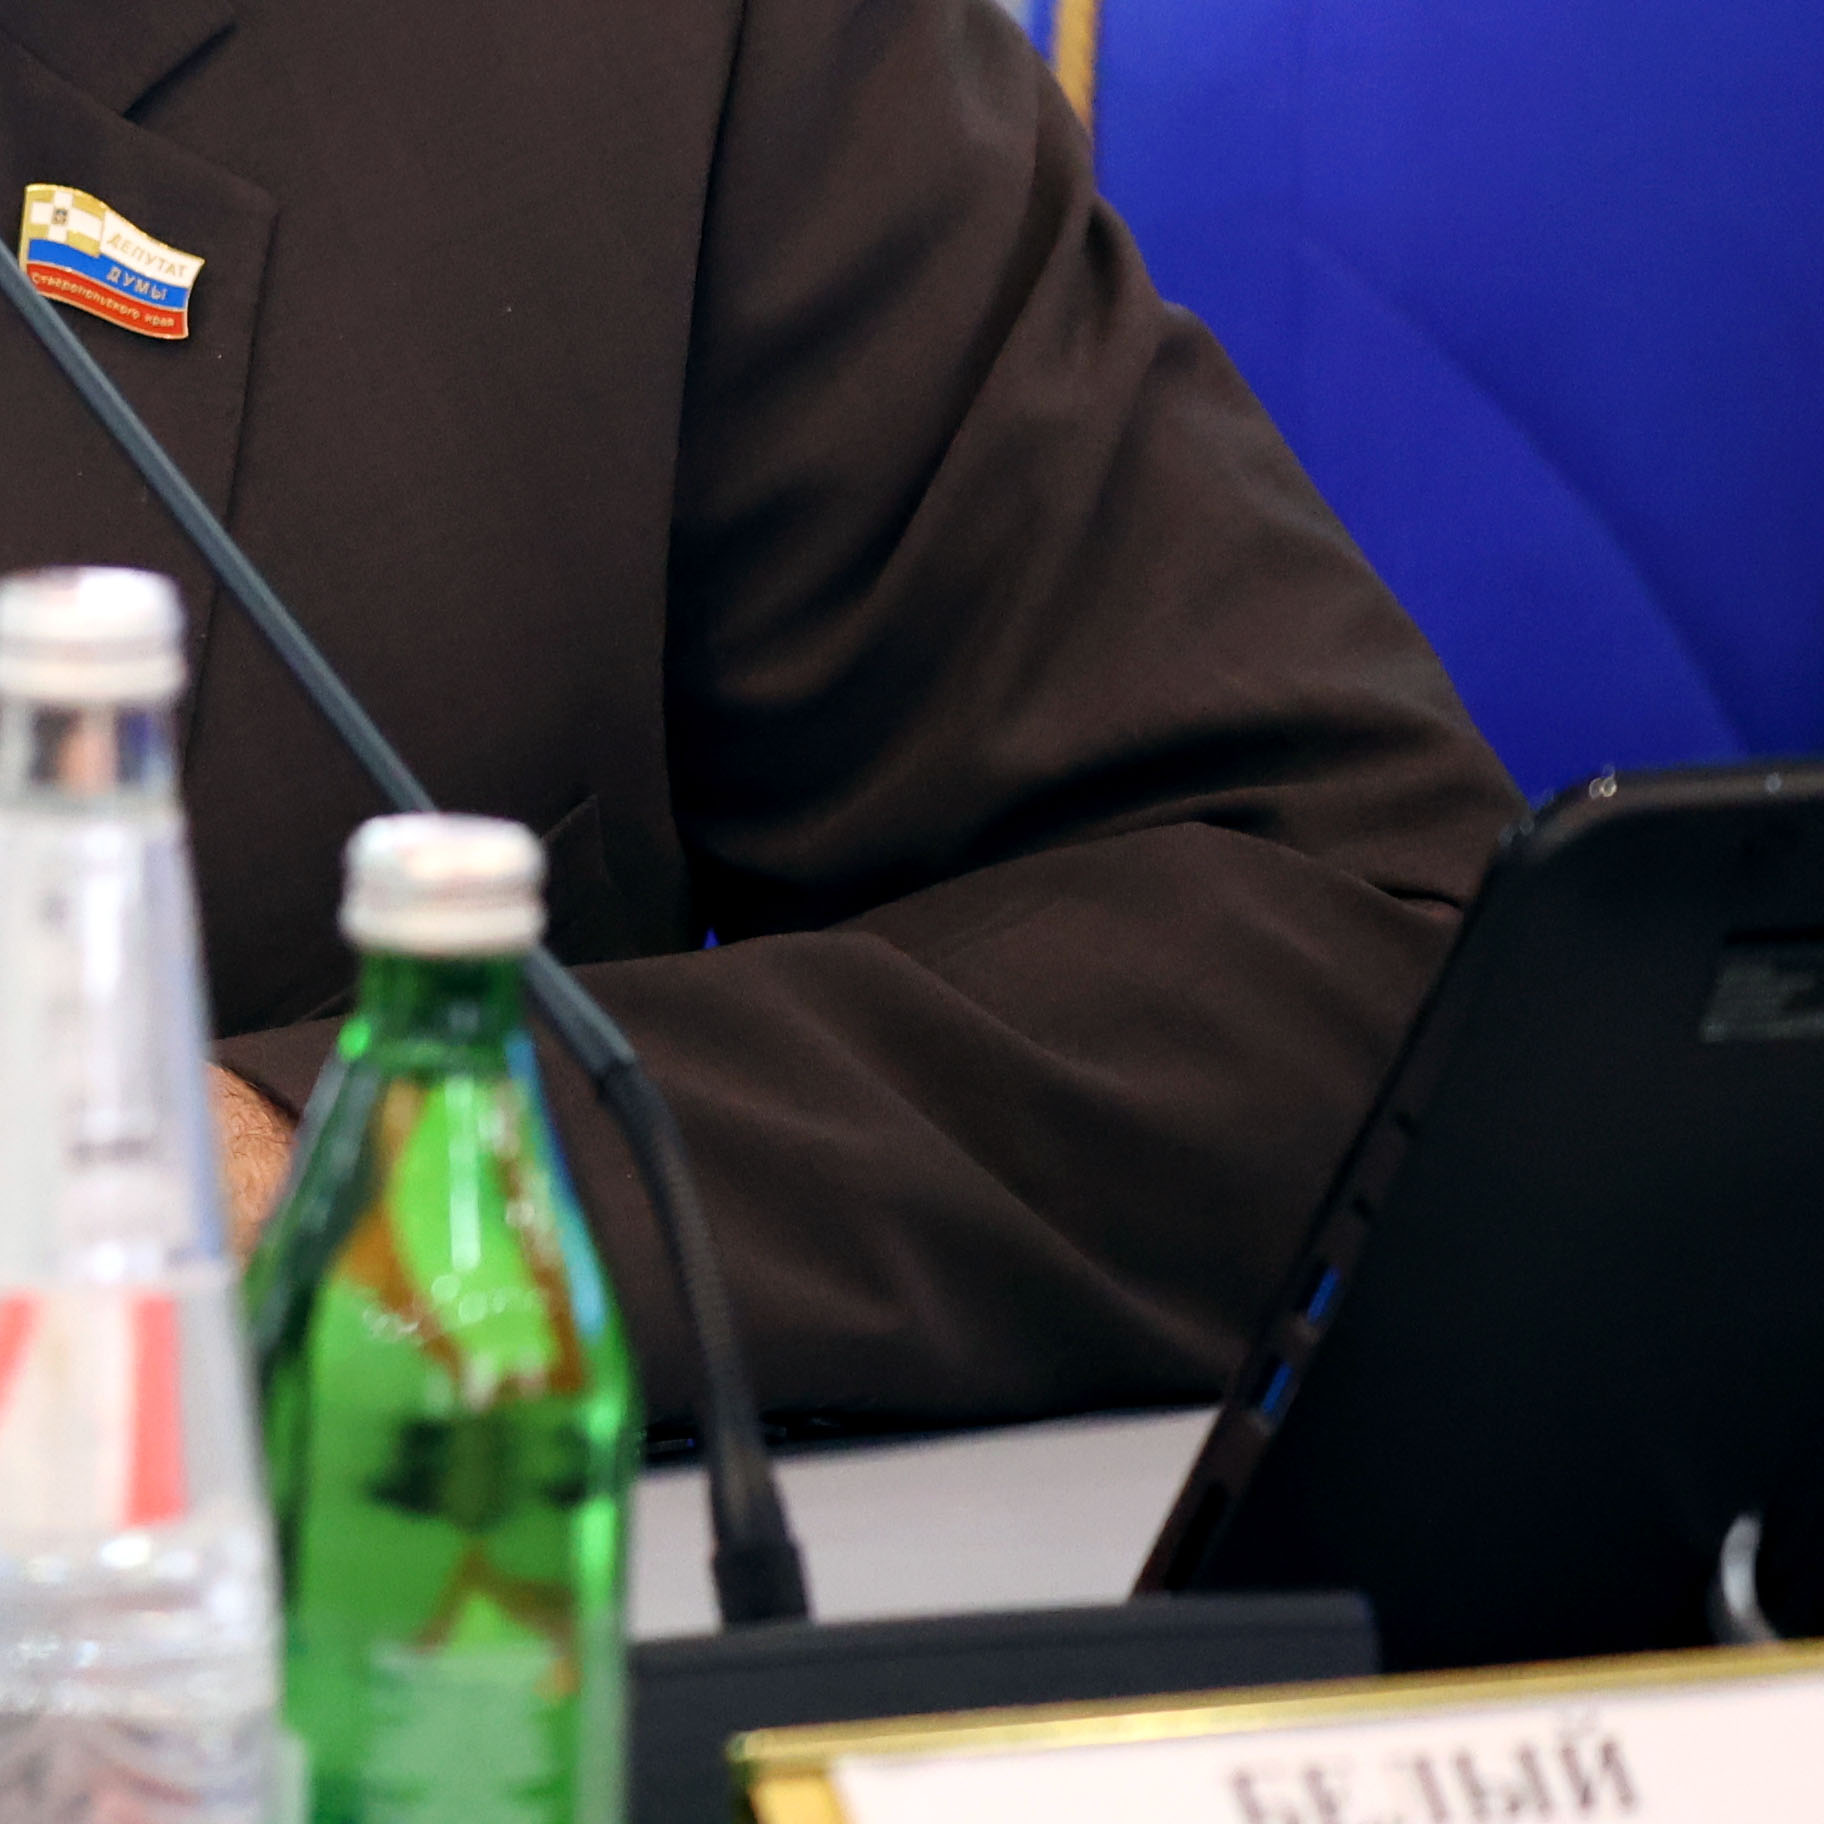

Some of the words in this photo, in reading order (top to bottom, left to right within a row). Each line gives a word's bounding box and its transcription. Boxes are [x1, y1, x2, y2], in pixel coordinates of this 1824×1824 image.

[108, 233, 185, 277] ДЕПУТАТ
[106, 266, 168, 300] ДУМЫ
[1228, 1704, 1640, 1824] БЕЛЫЙ
